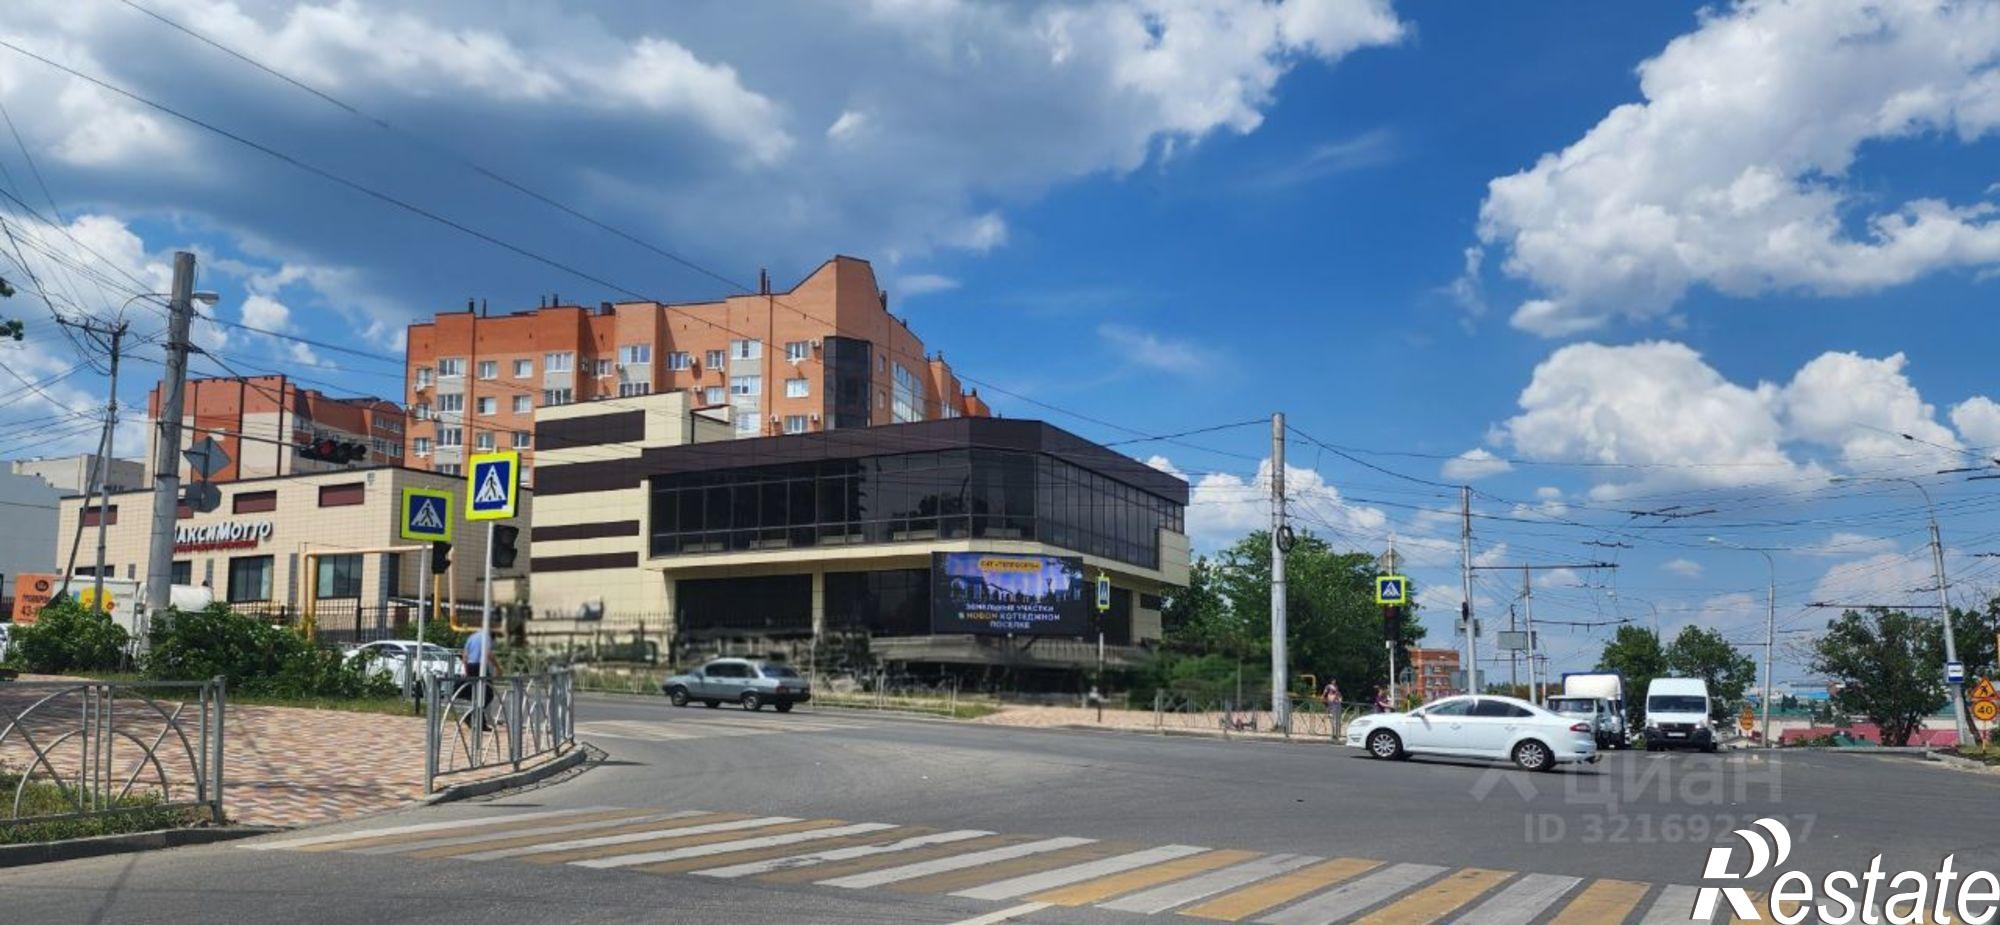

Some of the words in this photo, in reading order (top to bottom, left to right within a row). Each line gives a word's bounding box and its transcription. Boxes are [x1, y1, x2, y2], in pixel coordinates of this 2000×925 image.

[1016, 604, 1054, 612] УЧАСТКИ
[966, 612, 998, 620] НОВОМ
[1000, 612, 1060, 621] КОТТЕДЖНОМ
[1977, 706, 1993, 715] 40
